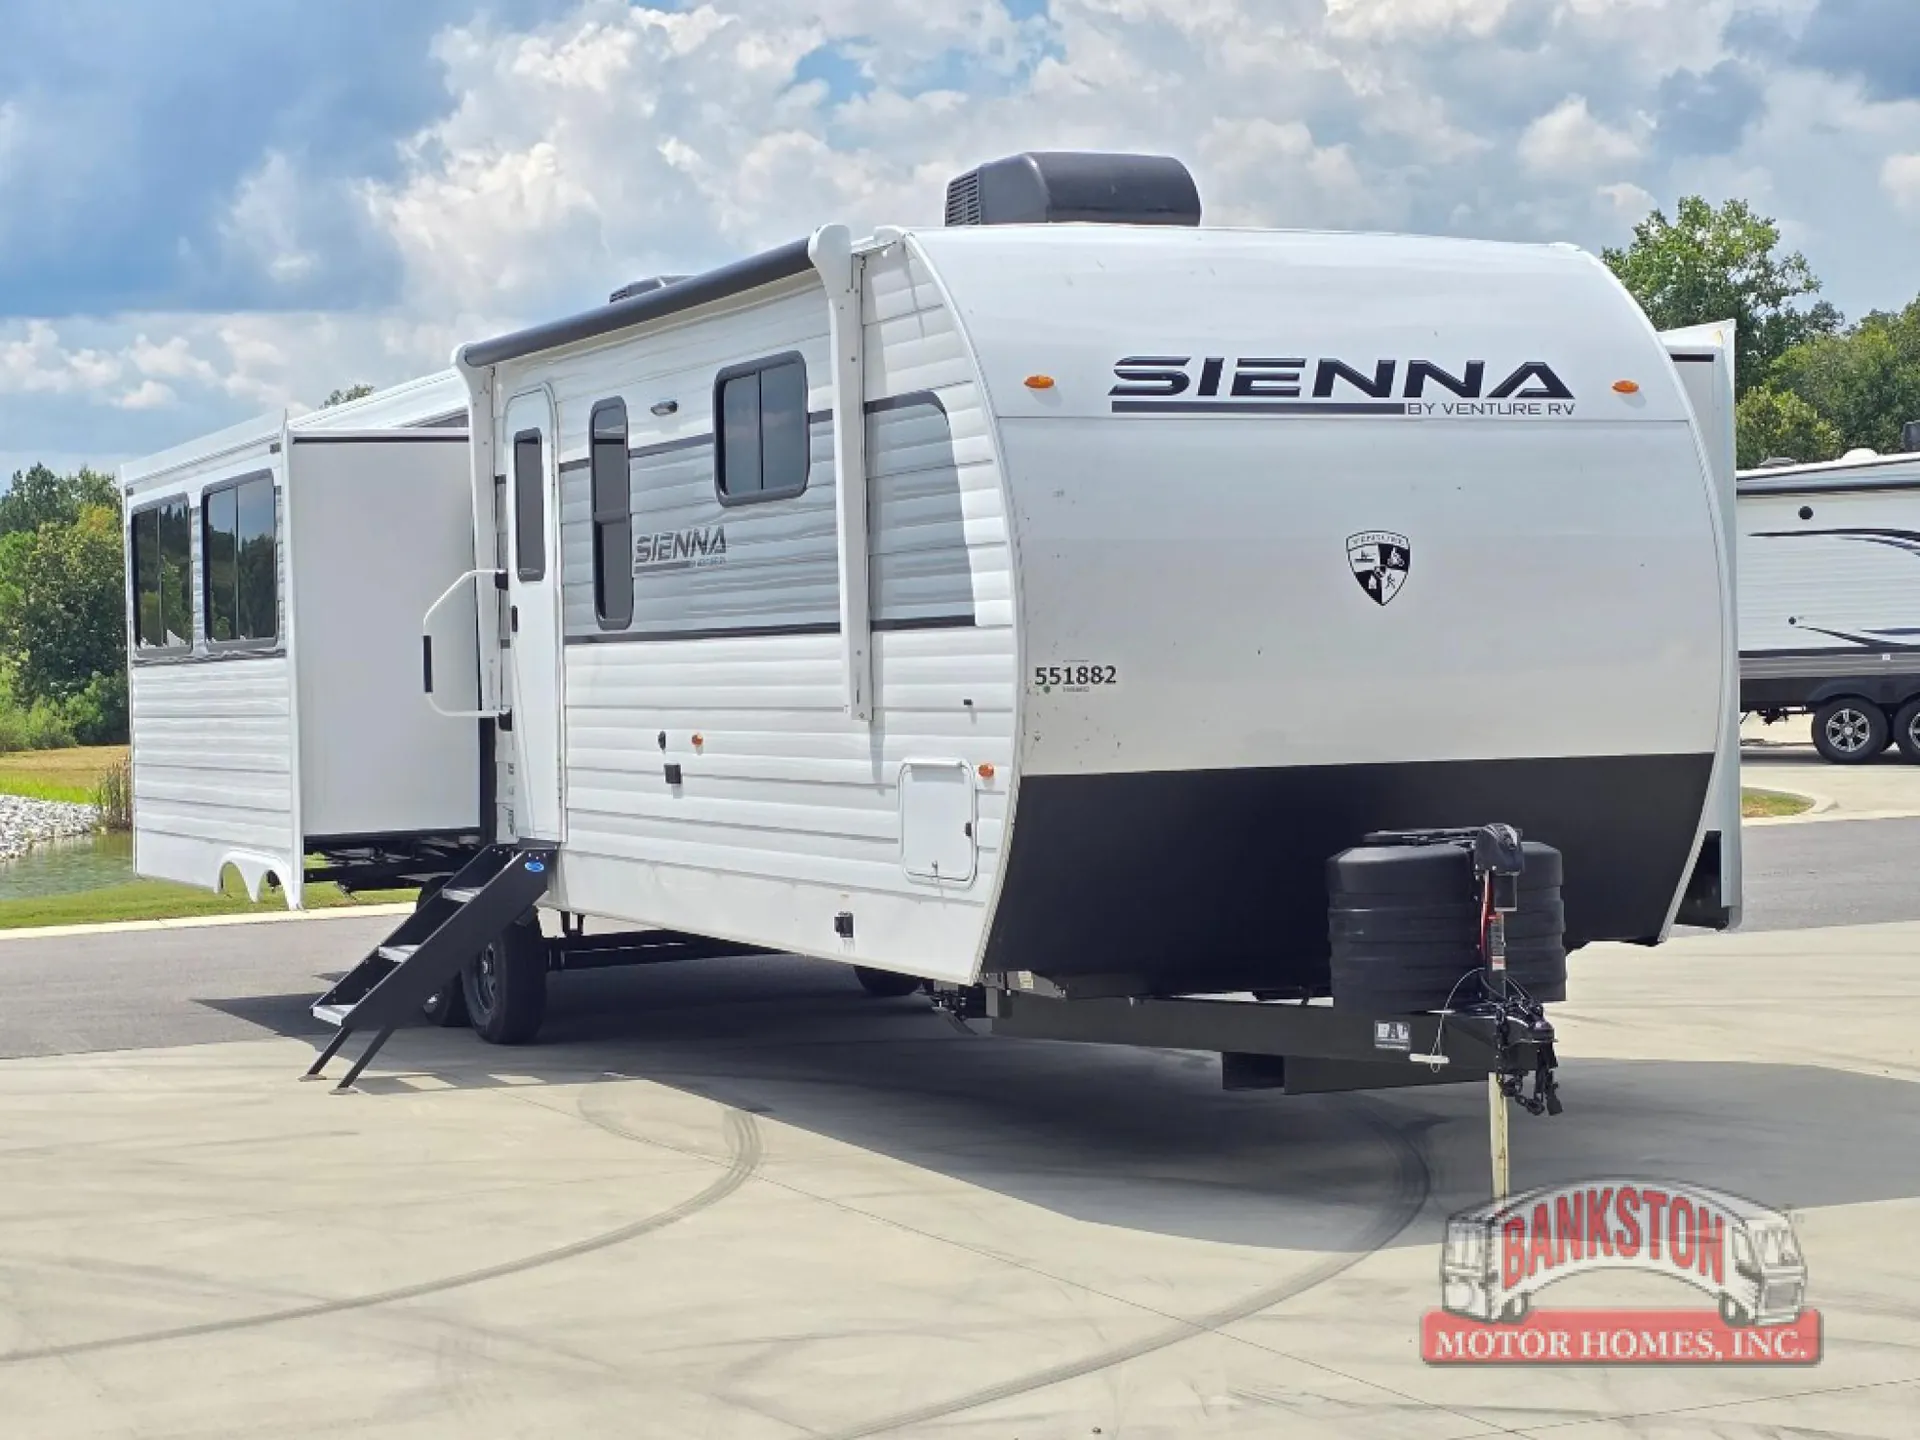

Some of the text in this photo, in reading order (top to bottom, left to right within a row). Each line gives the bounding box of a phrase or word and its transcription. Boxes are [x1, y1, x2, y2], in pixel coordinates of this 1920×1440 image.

[1108, 356, 1576, 399] SIENNA
[1407, 402, 1576, 415] BY VENTURE RV
[635, 525, 727, 563] SIENNA
[1034, 665, 1117, 685] 551882
